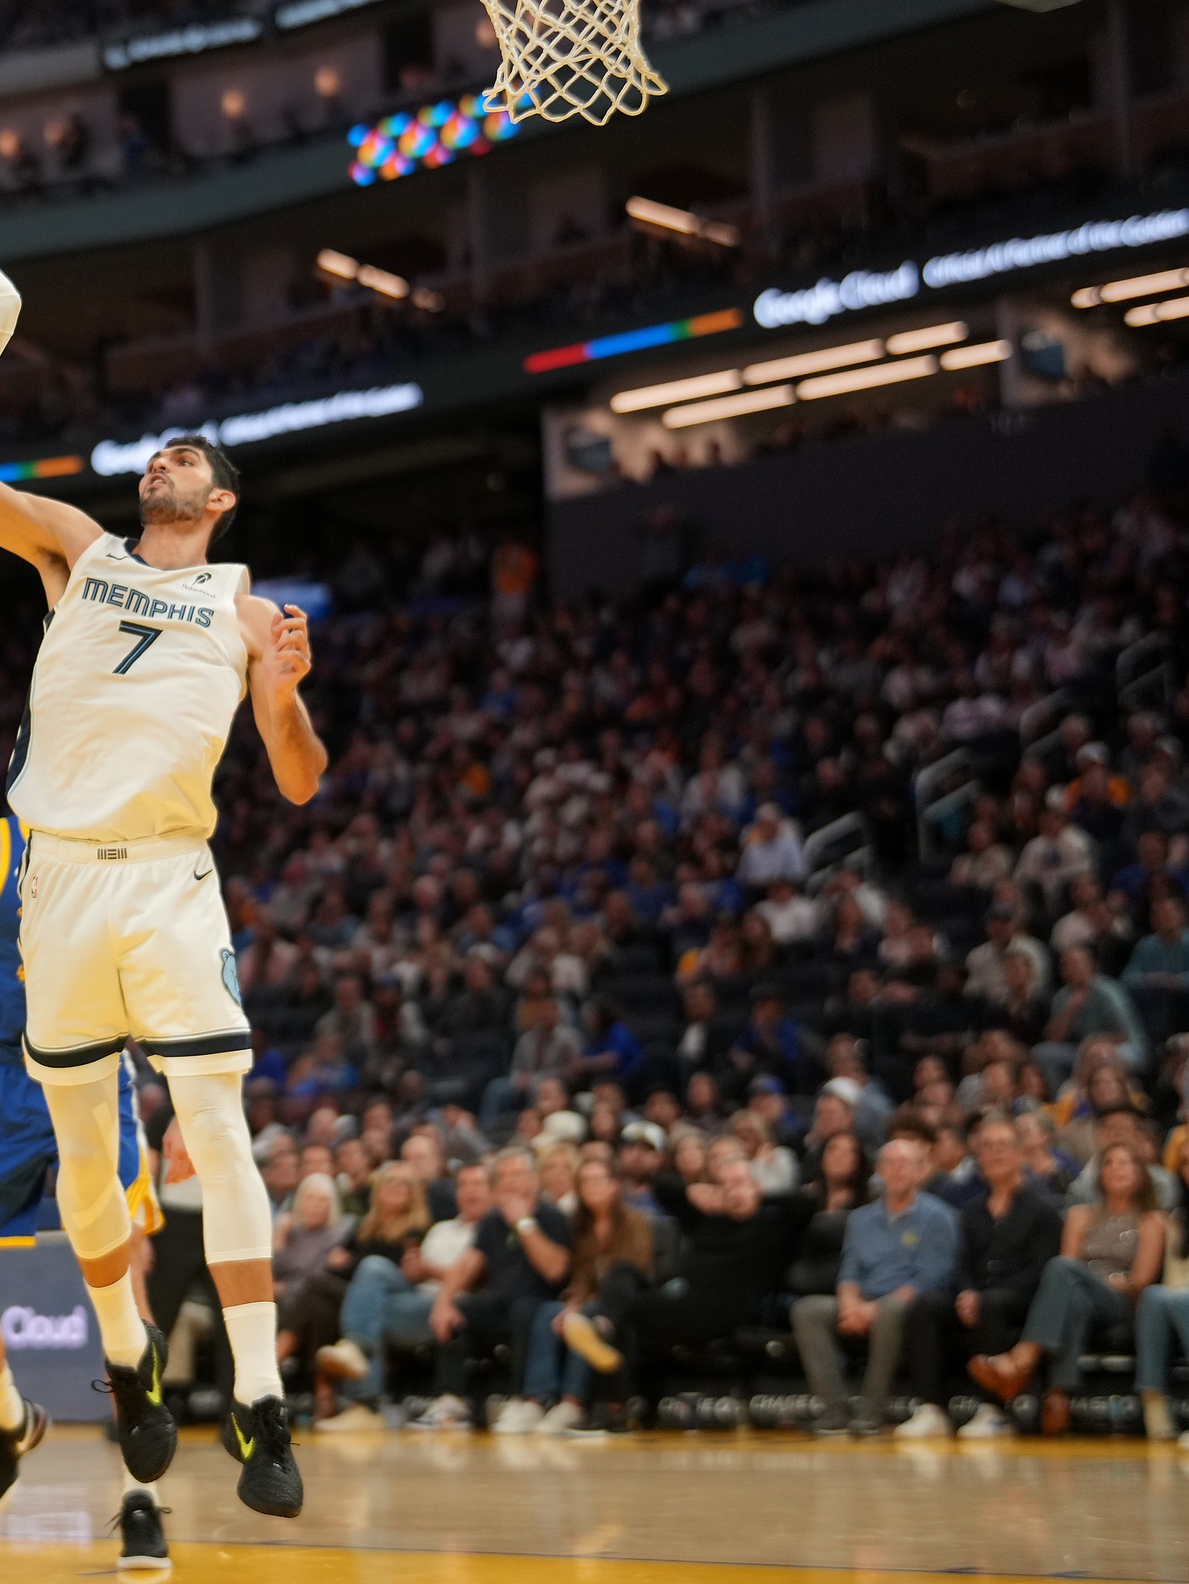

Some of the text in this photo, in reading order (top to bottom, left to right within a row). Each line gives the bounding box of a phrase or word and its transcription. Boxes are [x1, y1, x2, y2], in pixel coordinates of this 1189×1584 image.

[754, 277, 846, 328] Google
[840, 260, 919, 310] Cloud
[81, 577, 215, 628] MEMPHIS
[112, 620, 163, 675] 7
[1, 1305, 87, 1351] Cloud
